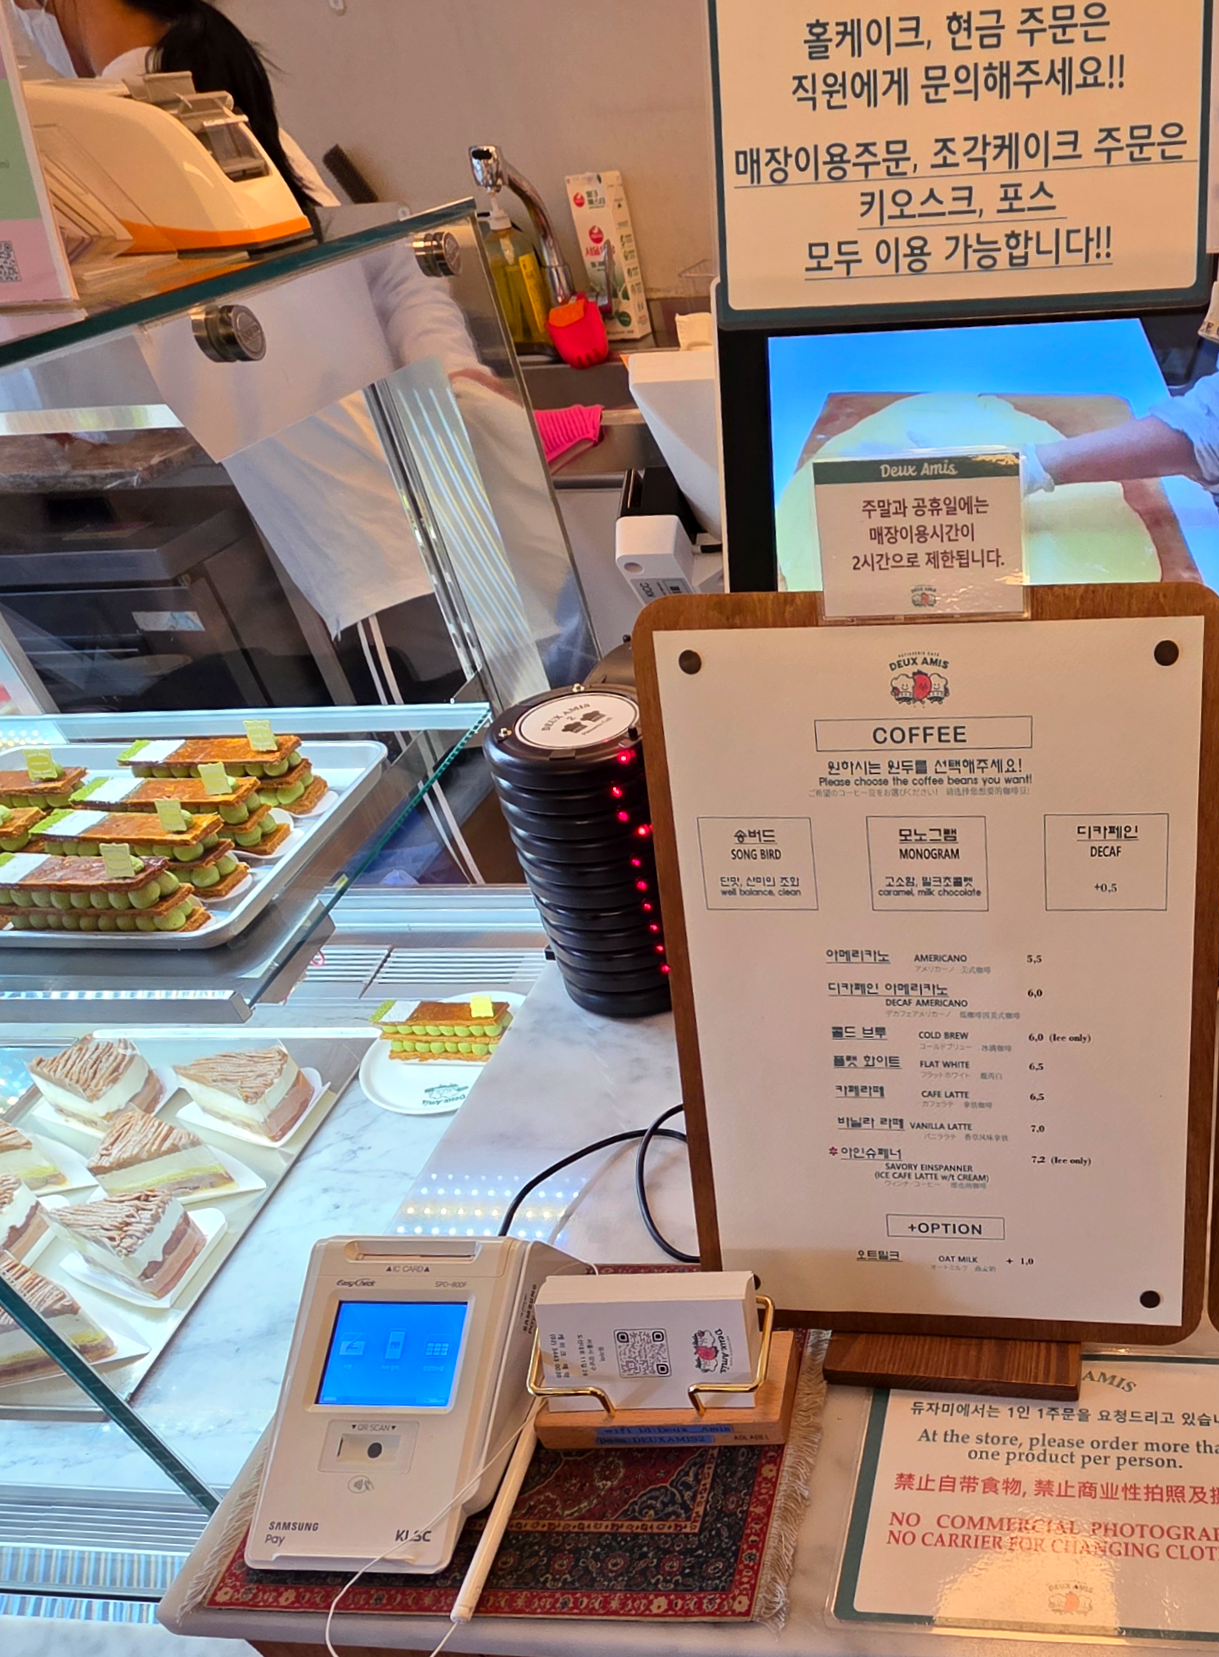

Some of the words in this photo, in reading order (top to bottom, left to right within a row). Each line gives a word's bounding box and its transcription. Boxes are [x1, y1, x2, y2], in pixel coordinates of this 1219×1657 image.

[804, 16, 932, 61] 홀케이크,
[946, 11, 1006, 51] 현금
[1017, 4, 1111, 45] 주문은
[792, 68, 909, 111] 직원에게
[921, 55, 1125, 104] 문의해주세요!!
[735, 140, 918, 185] 매장이용주문,
[931, 130, 1082, 170] 조각케이크
[1094, 123, 1188, 164] 주문은
[860, 187, 983, 227] 키오스크,
[996, 182, 1056, 216] 포스
[805, 241, 862, 276] 모두
[876, 236, 932, 273] 이용
[945, 226, 1112, 268] 가능합니다!!
[880, 464, 917, 478] Deux
[920, 460, 957, 476] Amis
[862, 499, 907, 519] 주말과
[912, 496, 989, 517] 공휴일에는
[870, 523, 975, 544] 매장이용시간이
[853, 553, 920, 571] 2시간으로
[925, 548, 1004, 569] 제한됩니다.
[889, 657, 918, 671] DEUX
[921, 657, 949, 669] AMIS
[873, 726, 967, 744] COFFEE
[828, 759, 881, 776] 원하시는
[934, 758, 1023, 774] 선택해주세요!
[819, 777, 851, 786] Please
[854, 777, 889, 786] choose
[893, 777, 908, 785] the
[912, 777, 943, 786] coffee
[947, 777, 978, 785] beans
[982, 777, 1000, 786] you
[1004, 775, 1032, 784] want!
[734, 829, 776, 842] 송버드
[899, 829, 957, 841] 모노그램
[1076, 825, 1139, 839] 디카페인
[731, 849, 757, 860] SONG
[760, 849, 781, 860] BIRD
[899, 849, 960, 860] MONOGRAM
[1090, 846, 1122, 858] DECAF
[826, 950, 890, 962] 아메리카노
[828, 983, 879, 995] 디카페인
[885, 983, 949, 996] 아메리카노
[908, 1220, 982, 1236] +OPTION
[1082, 1370, 1137, 1393] AMIS
[910, 1402, 1001, 1419] 듀자미에서는
[1008, 1406, 1030, 1420] 1인
[1037, 1407, 1091, 1423] 1주문을
[1097, 1409, 1174, 1426] 요청드리고
[917, 1430, 939, 1443] At
[943, 1430, 970, 1445] the
[975, 1432, 1023, 1449] store,
[1029, 1434, 1085, 1452] please
[1090, 1437, 1138, 1453] order
[1144, 1441, 1190, 1454] more
[968, 1448, 1000, 1461] one
[1005, 1449, 1075, 1467] product
[1081, 1454, 1111, 1468] per
[1115, 1456, 1183, 1470] person.
[269, 1521, 319, 1531] SAMSUNG
[889, 1512, 921, 1528] NO
[936, 1514, 1080, 1535] COMMERCIAL
[265, 1534, 285, 1547] Pay
[887, 1530, 917, 1545] NO
[921, 1532, 1003, 1551] CARRIER
[1008, 1535, 1046, 1553] FOR
[1051, 1538, 1160, 1559] CHANGING
